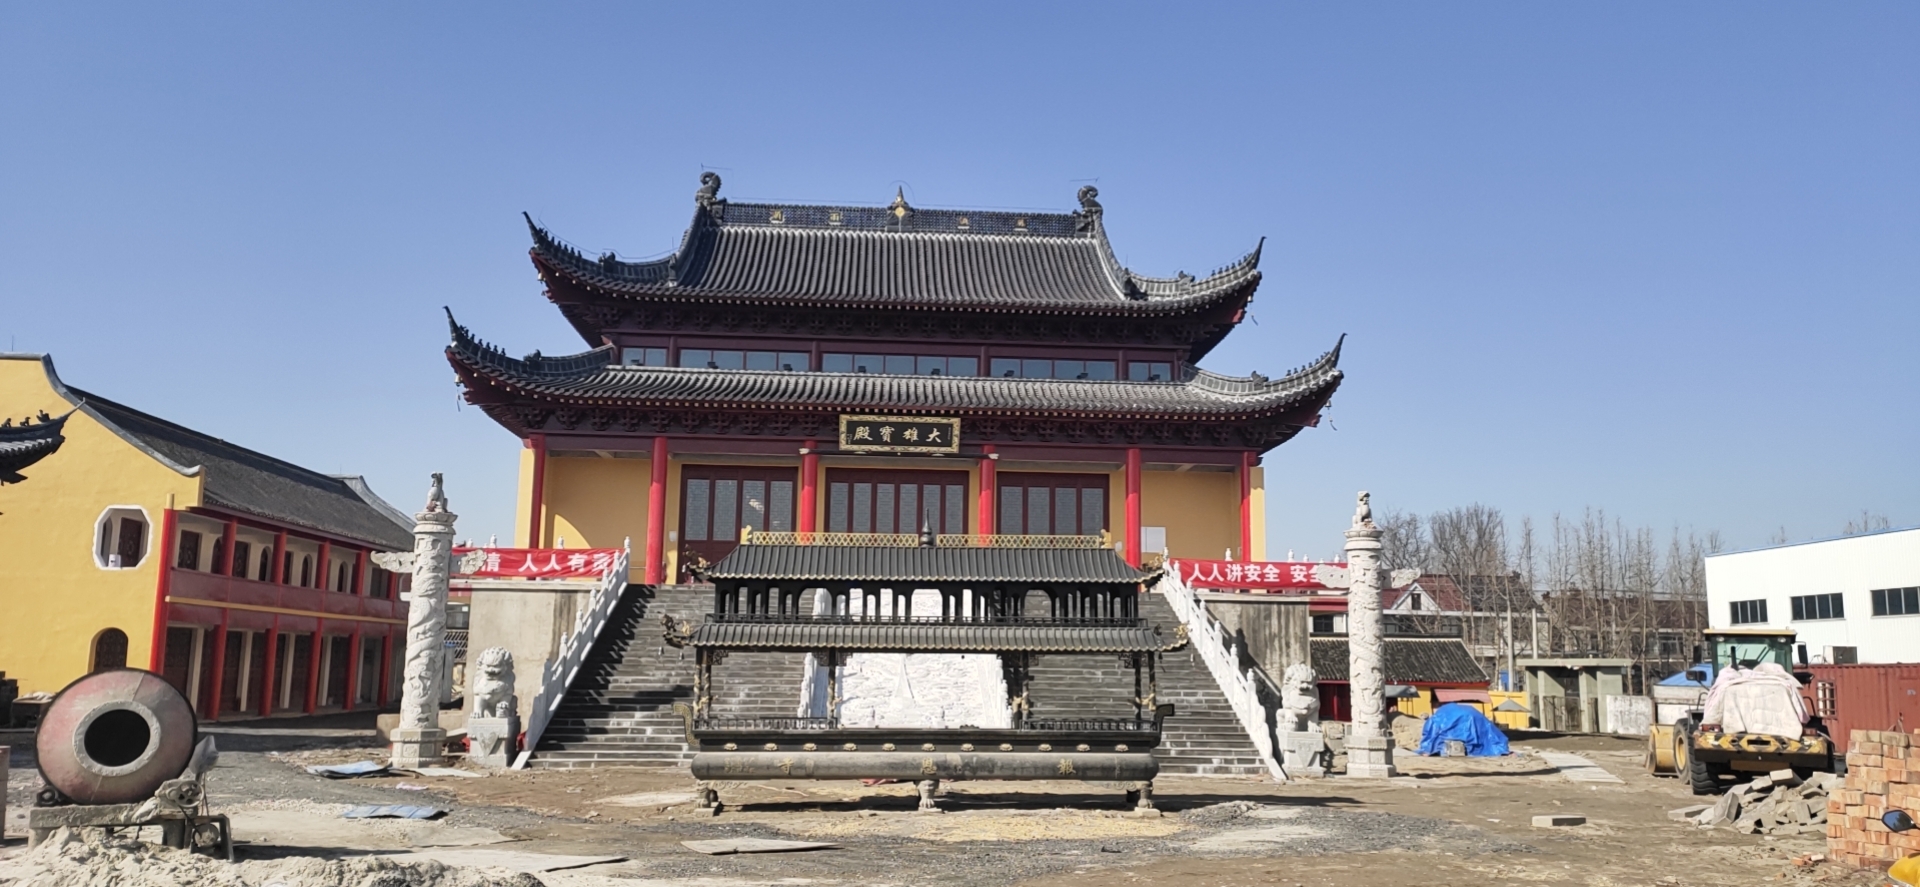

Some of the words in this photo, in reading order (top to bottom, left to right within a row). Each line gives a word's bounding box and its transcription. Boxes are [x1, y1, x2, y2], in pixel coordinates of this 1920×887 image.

[853, 425, 942, 443] 大雄寶殿
[1188, 563, 1281, 583] 人人讲安全
